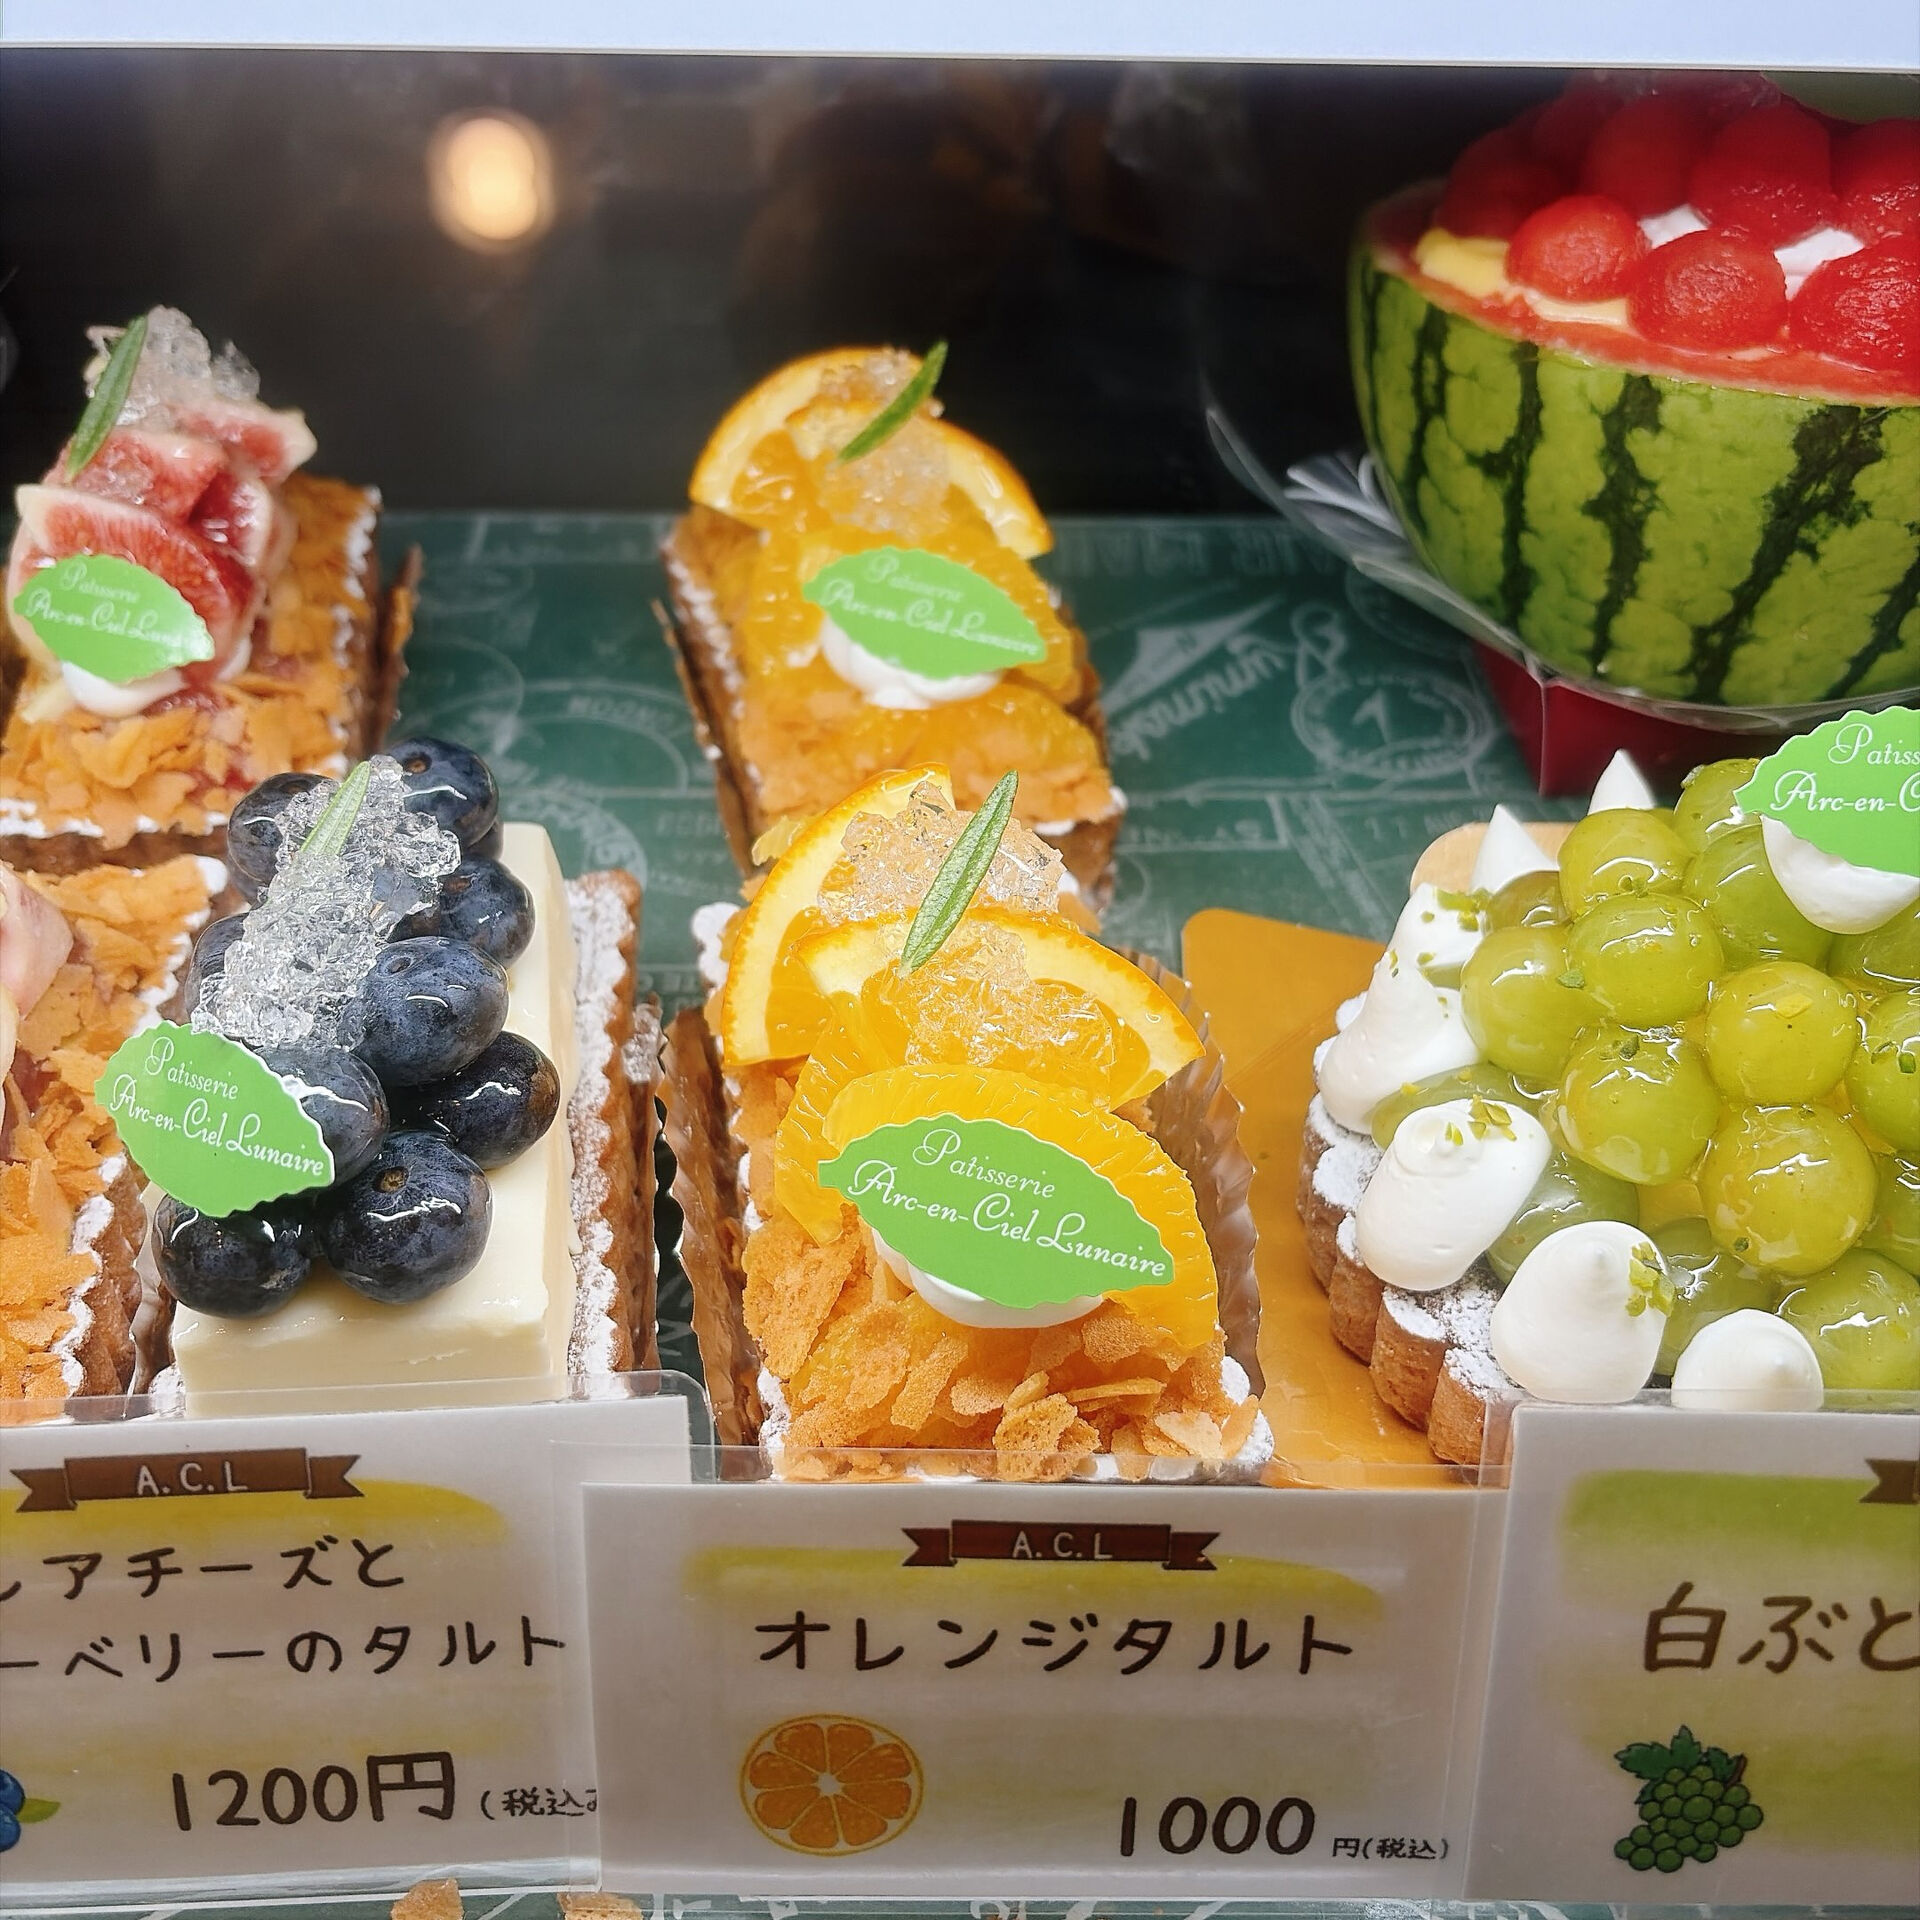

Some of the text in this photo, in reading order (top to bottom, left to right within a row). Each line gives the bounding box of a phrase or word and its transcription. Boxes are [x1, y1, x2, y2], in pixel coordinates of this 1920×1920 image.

[145, 1036, 238, 1100] Patisserie
[110, 1074, 324, 1176] Arc-en-Ciel Lunaire
[913, 1129, 1055, 1199] Patisserie
[848, 1160, 1166, 1277] Arc-en-Ciel Lunaire
[137, 1461, 248, 1496] A.C.L
[1012, 1530, 1113, 1559] A.C.L
[755, 1611, 1353, 1676] オレンジタルト
[172, 1752, 456, 1832] 1200円
[1121, 1796, 1449, 1860] 1000 円(税込)
